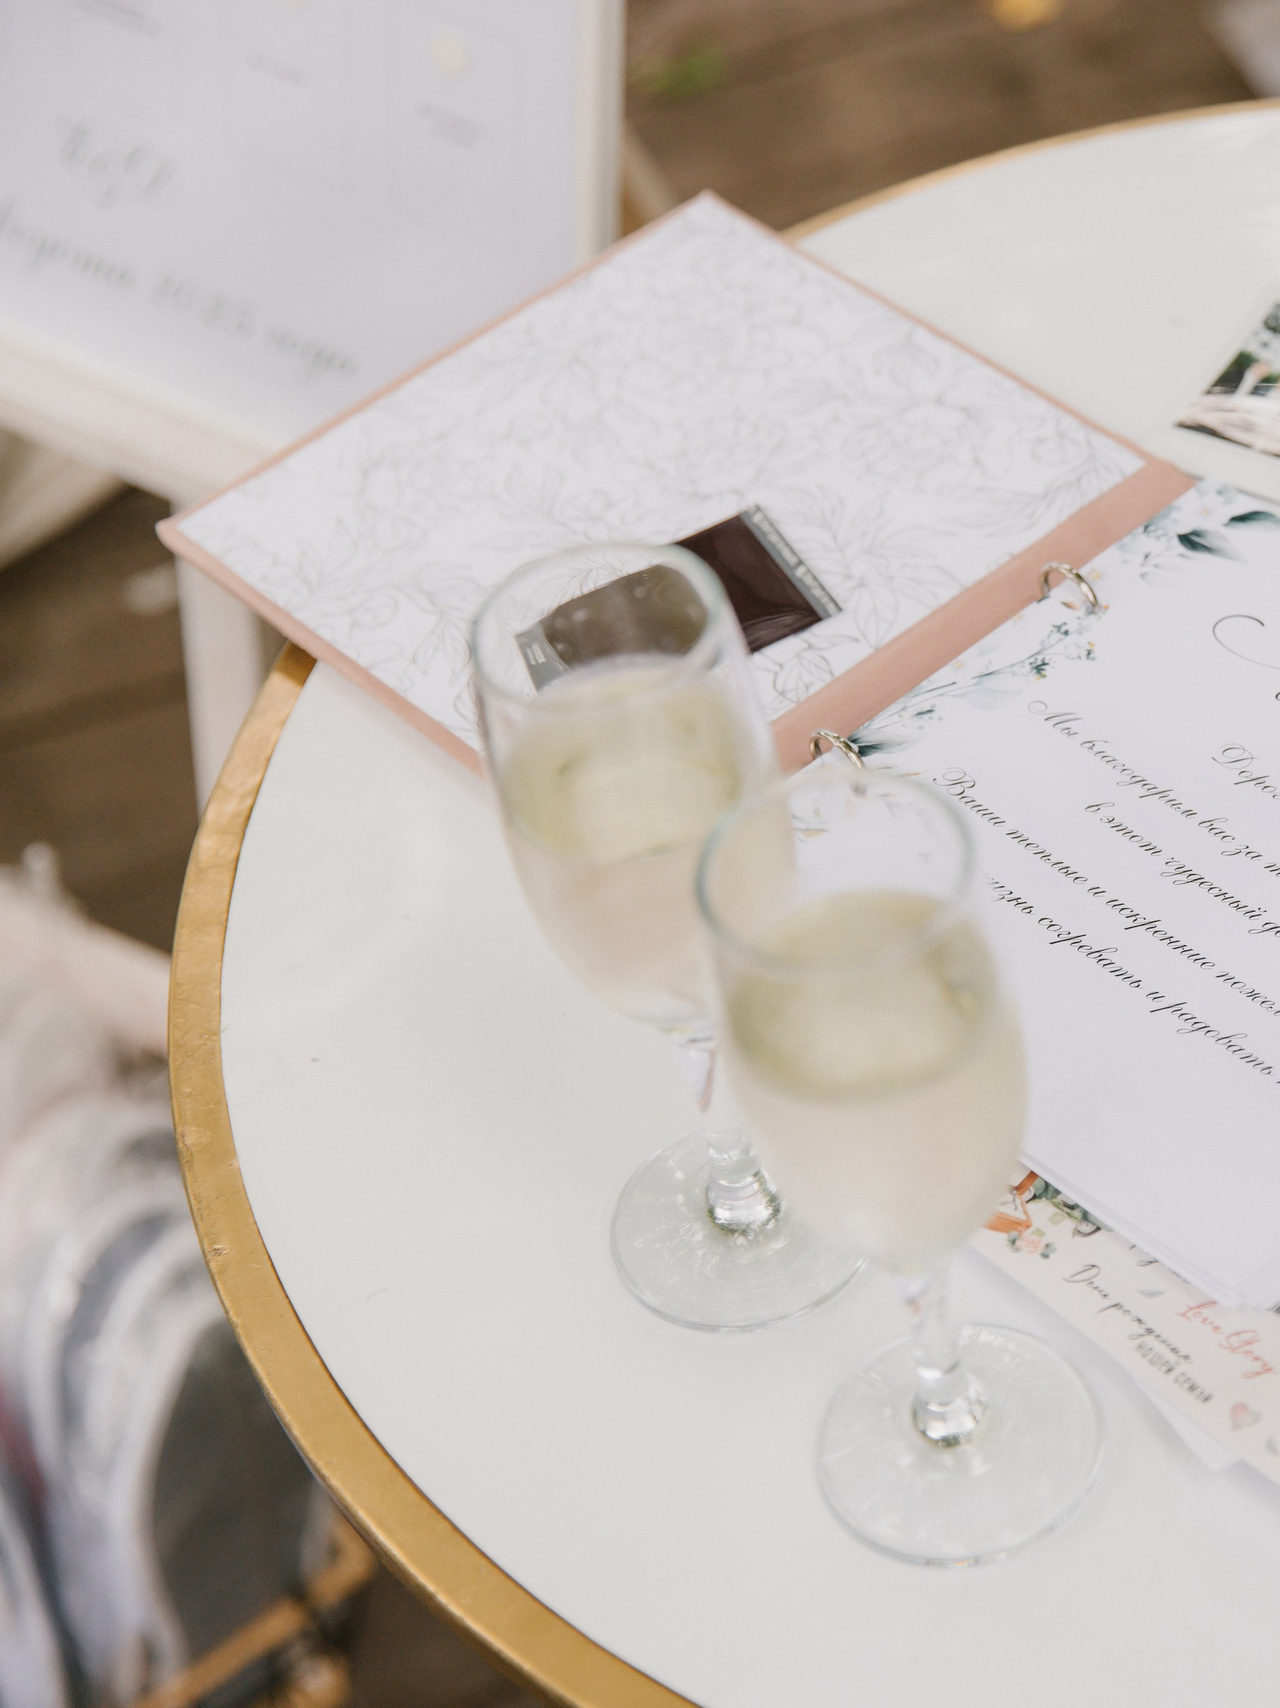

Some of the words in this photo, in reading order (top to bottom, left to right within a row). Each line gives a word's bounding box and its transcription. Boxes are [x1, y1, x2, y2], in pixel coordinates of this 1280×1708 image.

[1028, 700, 1084, 739] Мы
[1080, 739, 1198, 819] благодарим
[1198, 817, 1236, 843] вас
[1221, 844, 1262, 861] за
[933, 767, 1006, 827] Ваши
[1005, 829, 1088, 884] теплые
[1087, 886, 1106, 898] и
[1105, 898, 1216, 969] искренние
[1100, 816, 1163, 856] этот
[1160, 857, 1267, 920] чудесный
[1037, 916, 1143, 990] согревать
[1145, 991, 1165, 1002] и
[1149, 1001, 1275, 1076] радовать
